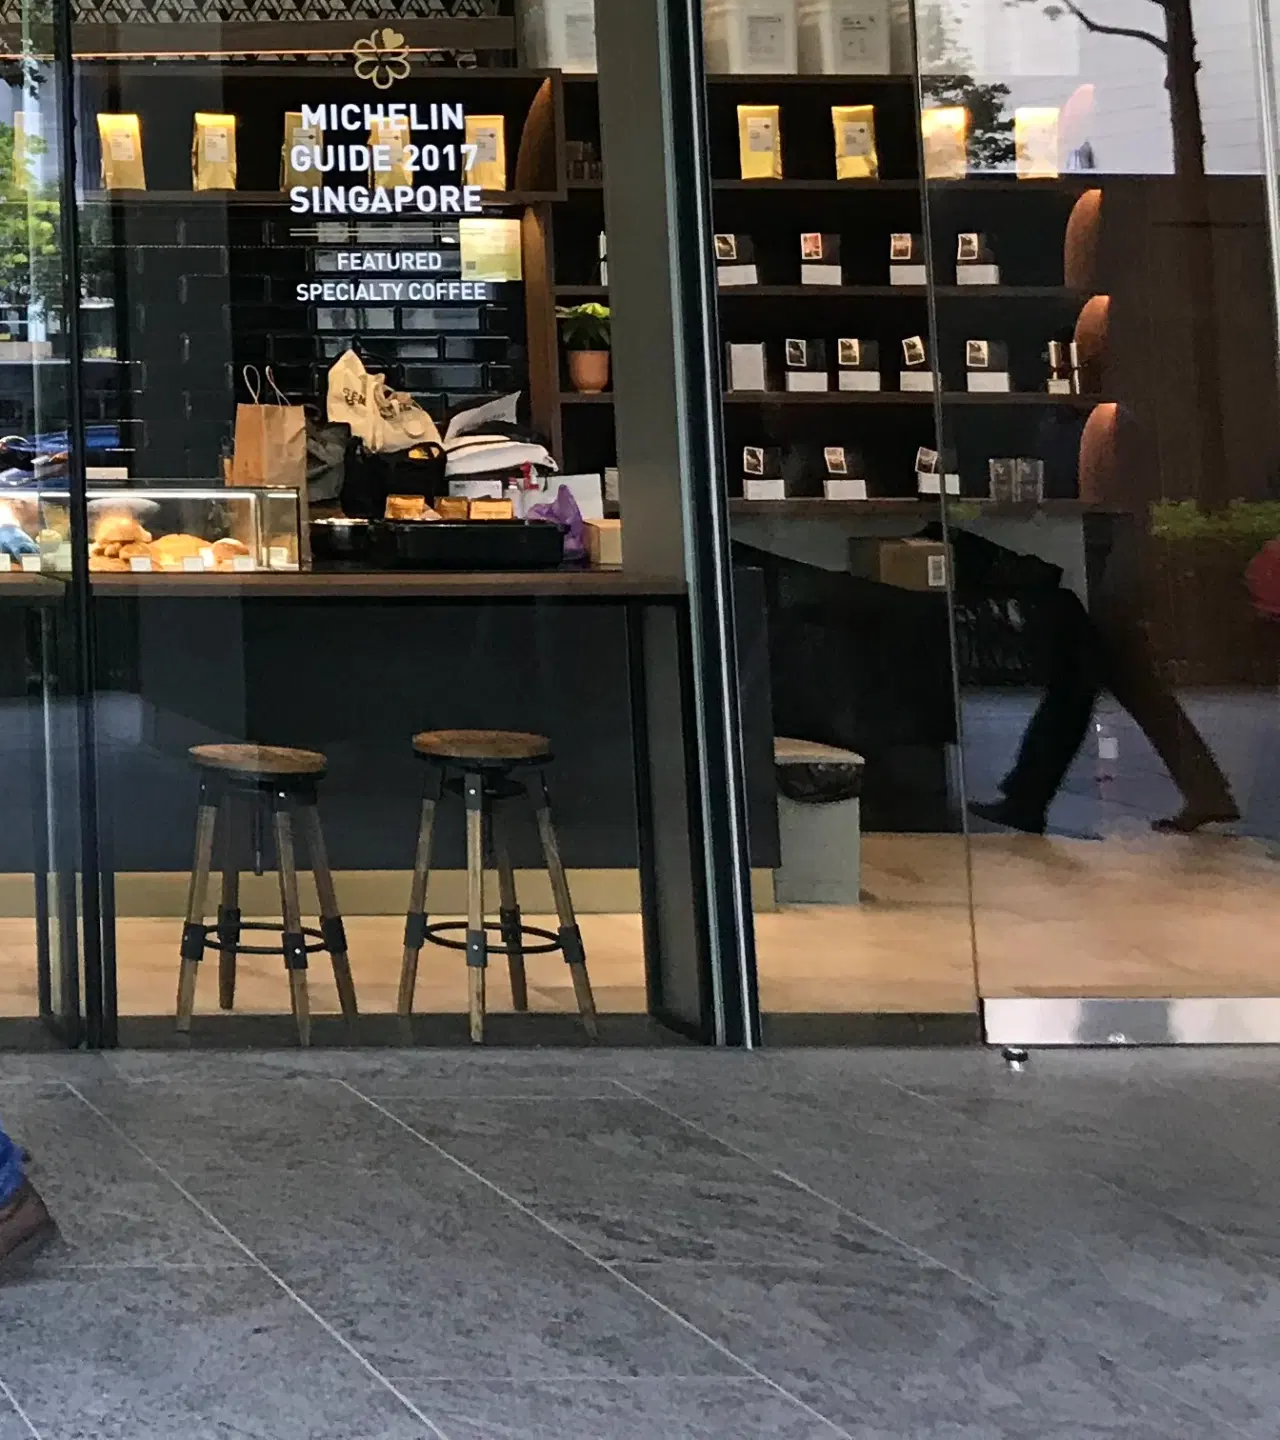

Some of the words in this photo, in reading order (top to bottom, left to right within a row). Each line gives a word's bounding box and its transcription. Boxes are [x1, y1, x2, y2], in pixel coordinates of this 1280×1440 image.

[301, 103, 464, 131] MICHELIN
[290, 144, 392, 172] GUIDE
[403, 144, 478, 171] 2017
[290, 185, 483, 213] SINGAPORE
[338, 253, 441, 271] FEATURED
[296, 283, 403, 301] SPECIALTY
[408, 283, 486, 301] COFFEE
